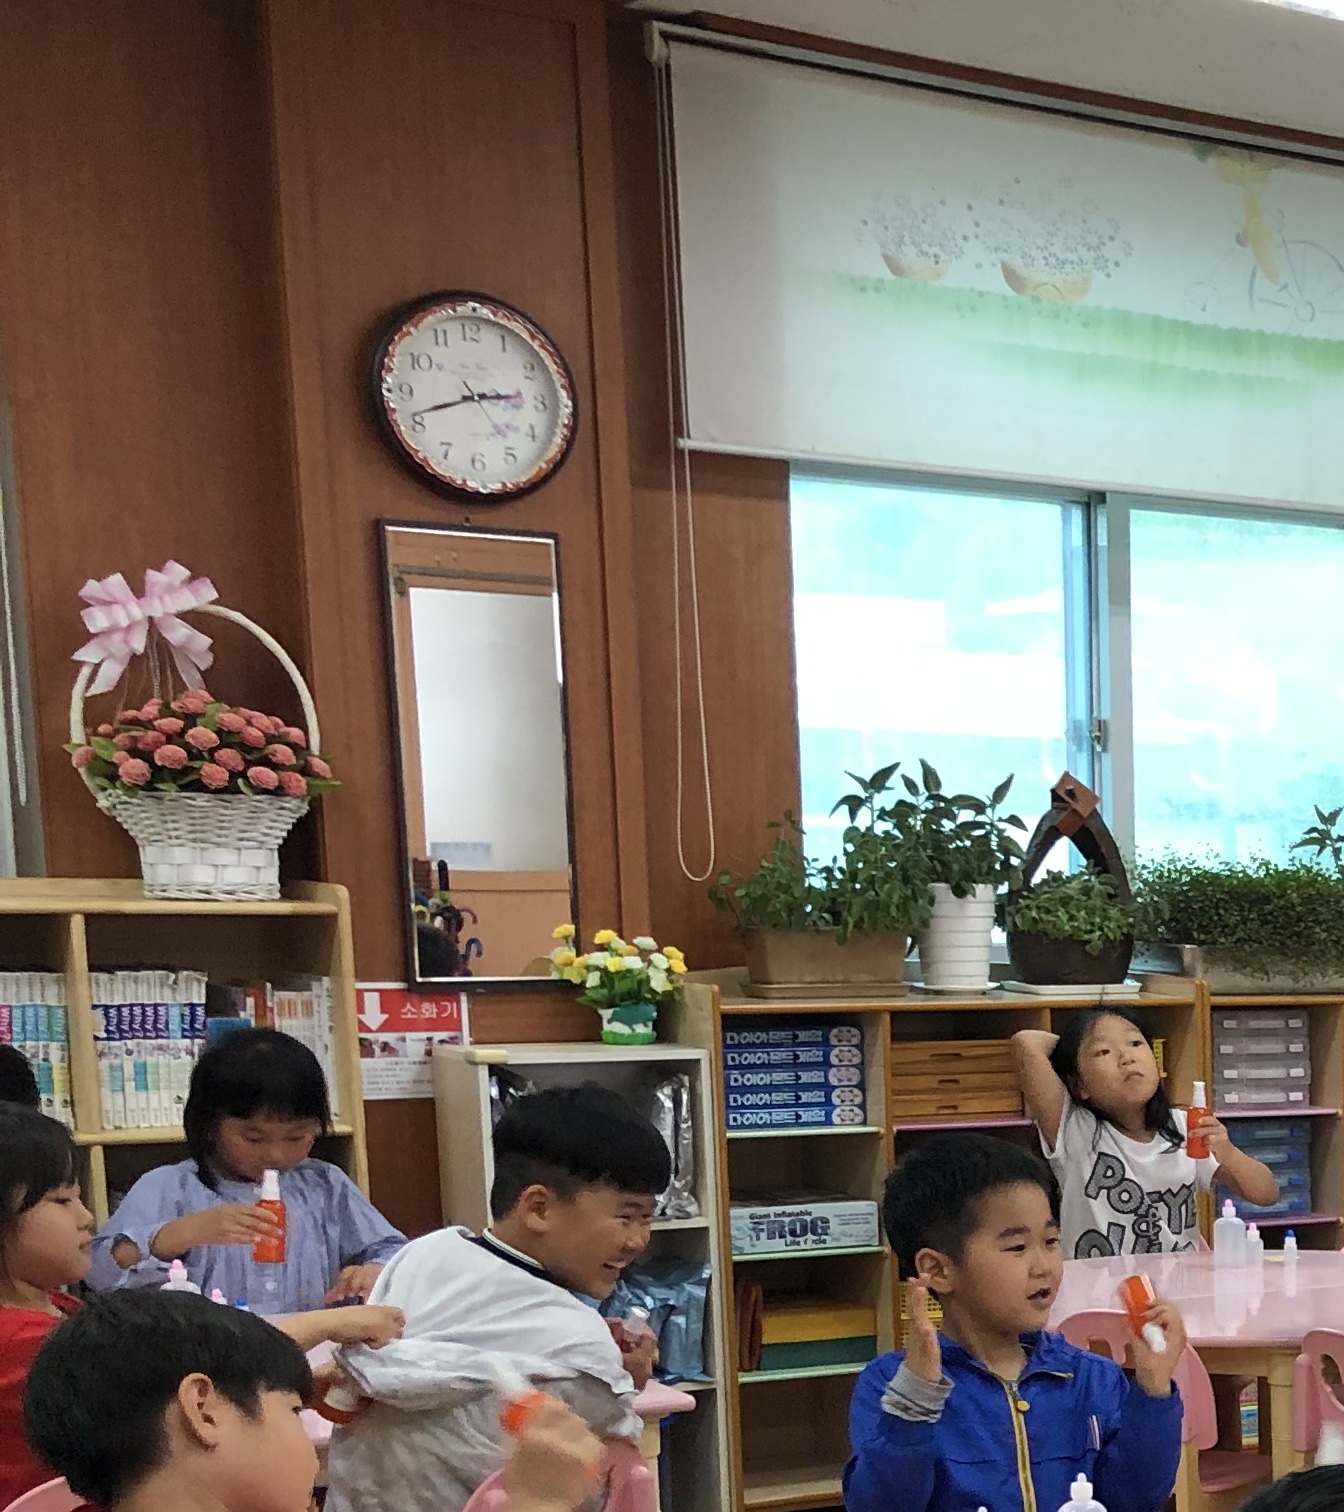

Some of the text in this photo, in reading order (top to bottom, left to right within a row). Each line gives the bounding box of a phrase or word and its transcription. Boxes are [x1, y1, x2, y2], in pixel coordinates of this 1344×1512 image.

[433, 328, 449, 348] 11
[460, 323, 481, 343] 12
[500, 335, 507, 353] 1
[409, 352, 433, 372] 10
[523, 362, 535, 381] 2
[398, 382, 414, 401] 9
[533, 395, 547, 413] 3
[411, 414, 426, 434] 8
[525, 423, 537, 443] 4
[439, 441, 453, 460] 7
[503, 446, 517, 465] 5
[471, 452, 486, 472] 6
[400, 1001, 458, 1019] 소화기
[726, 1031, 794, 1045] 다이아몬드
[726, 1051, 795, 1065] 다이아몬드
[729, 1071, 796, 1086] 다이아몬드
[729, 1092, 796, 1106] 다이아몬드
[728, 1111, 796, 1125] 다이아몬드
[750, 1216, 831, 1242] FROG
